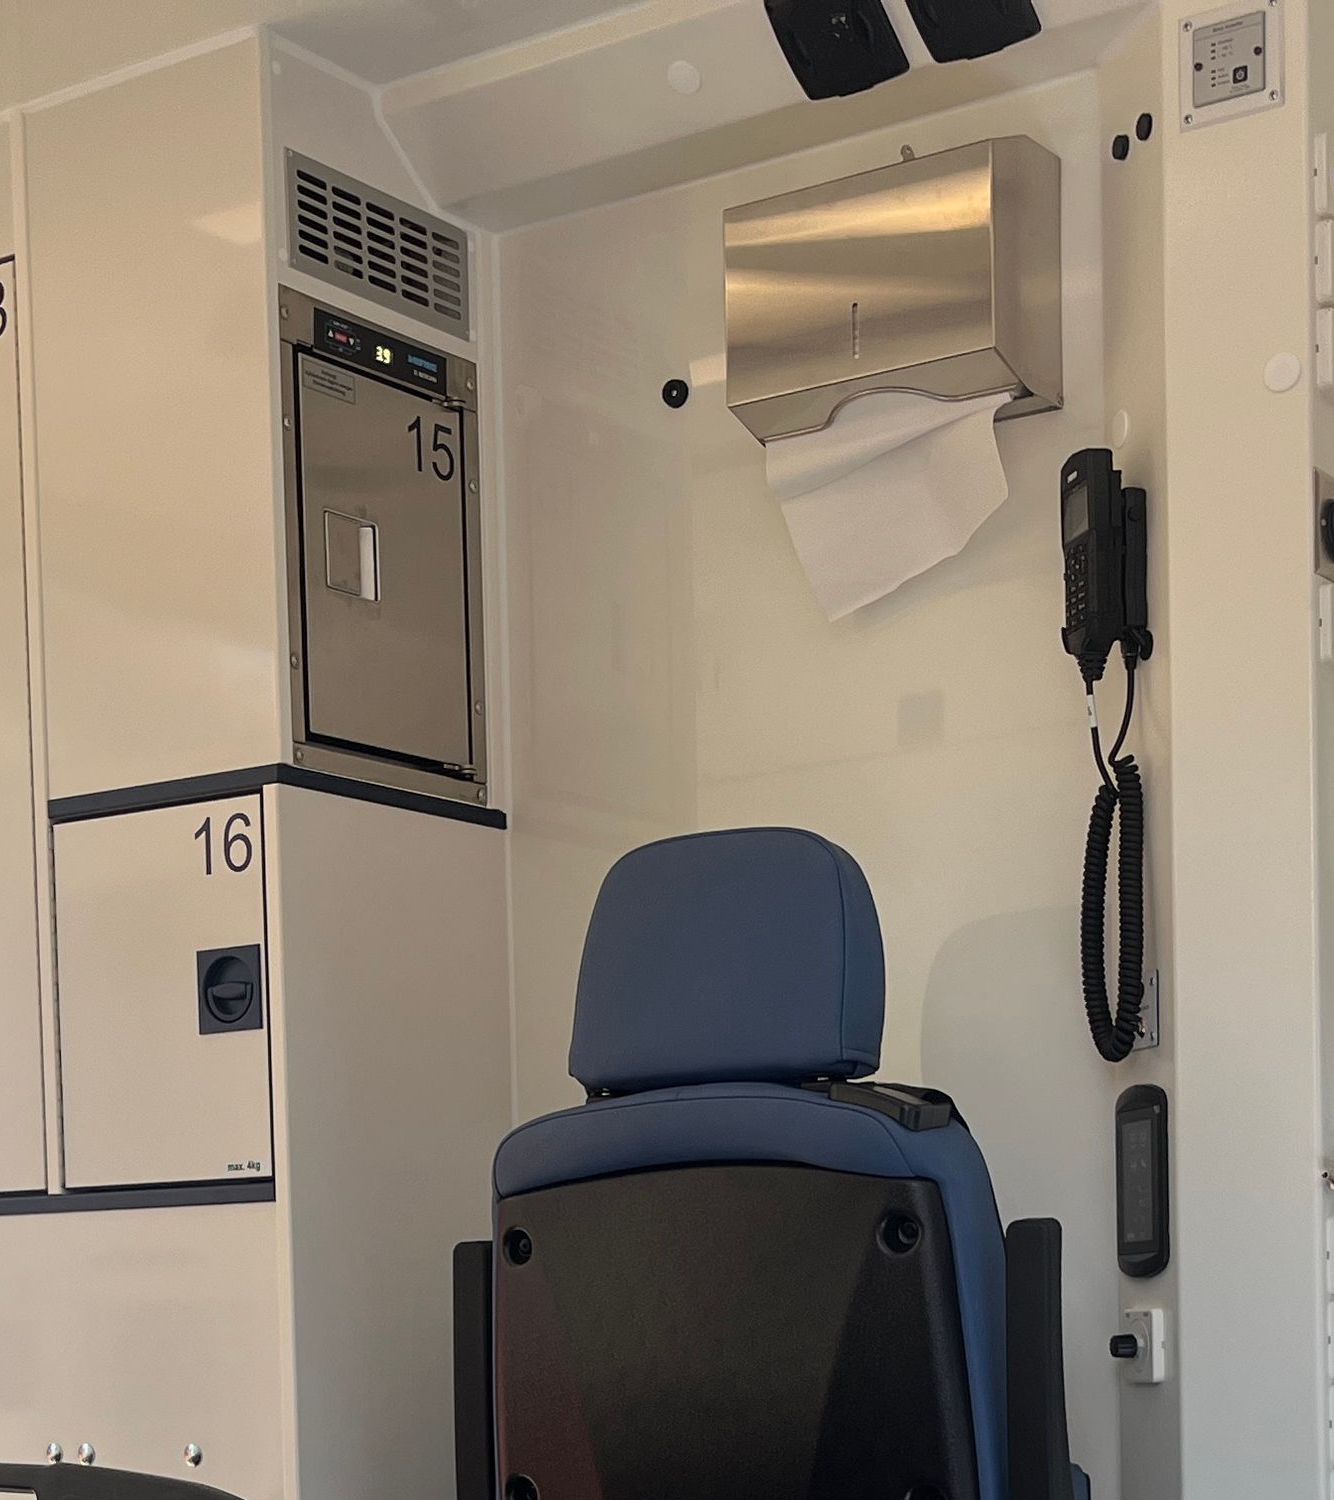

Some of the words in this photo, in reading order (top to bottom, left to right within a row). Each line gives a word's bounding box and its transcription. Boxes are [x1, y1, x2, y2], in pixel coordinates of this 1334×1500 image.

[408, 416, 454, 481] 15
[194, 813, 252, 875] 16
[227, 1163, 245, 1171] max.
